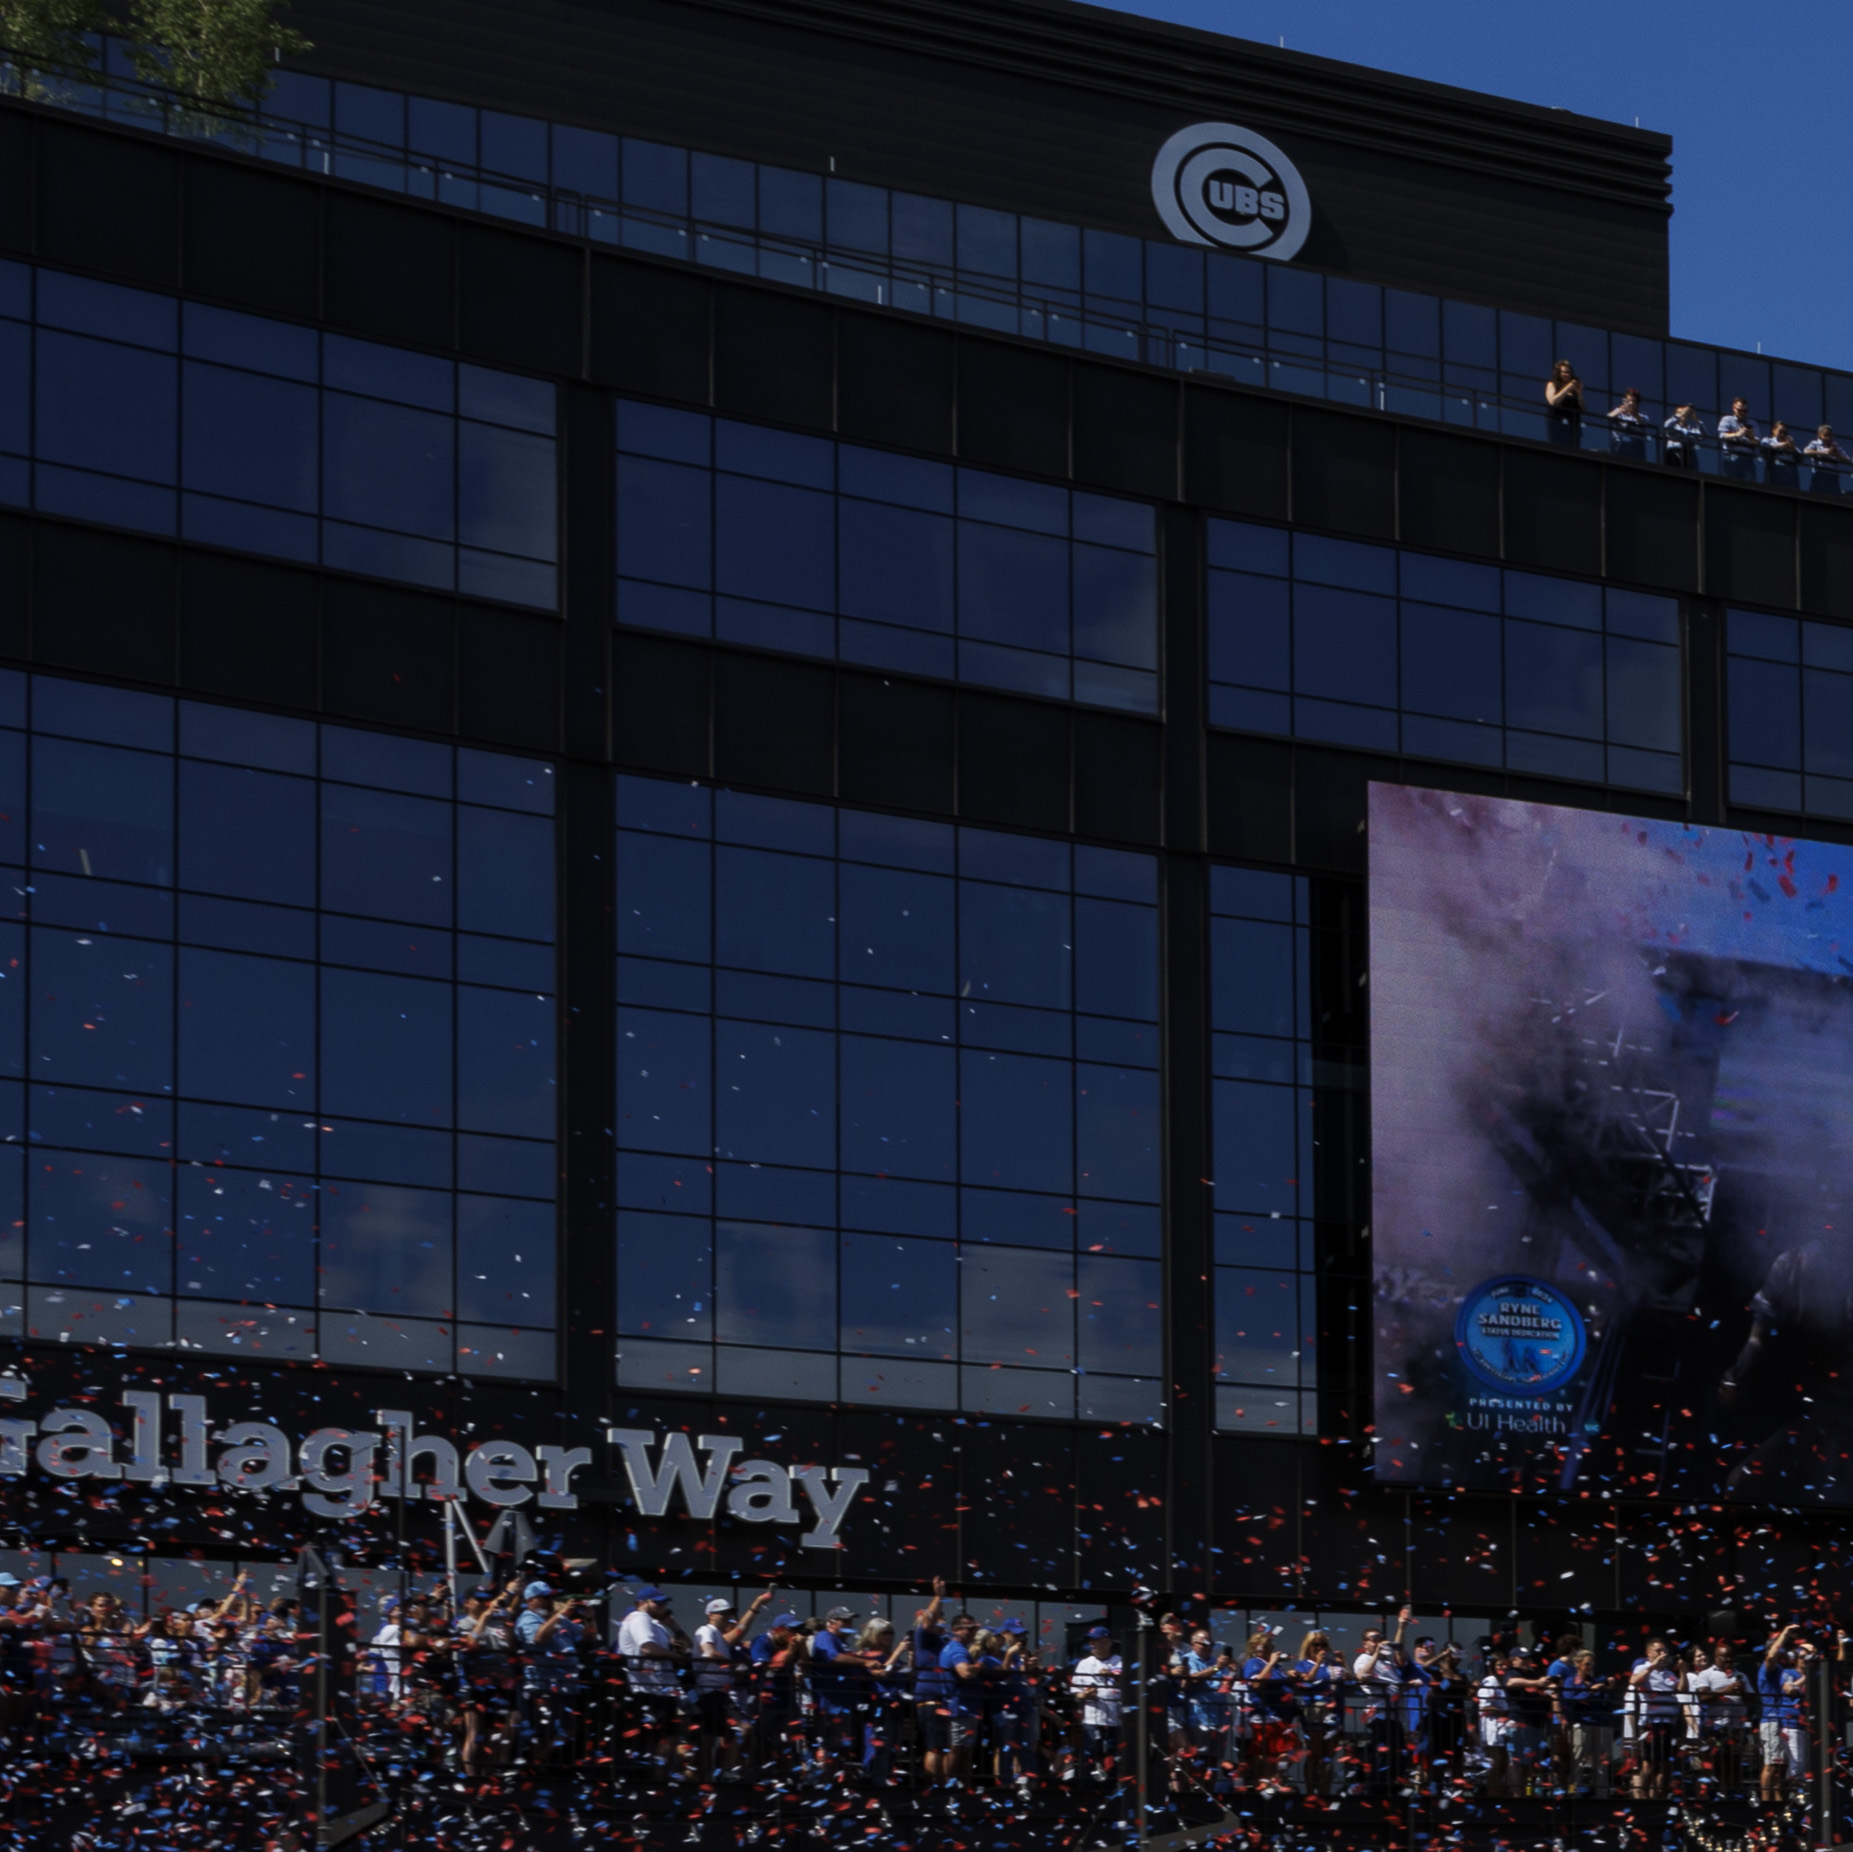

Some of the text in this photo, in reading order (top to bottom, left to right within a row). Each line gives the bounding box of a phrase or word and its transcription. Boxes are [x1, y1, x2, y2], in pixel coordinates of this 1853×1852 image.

[1500, 1302, 1541, 1315] RYNE
[1478, 1313, 1563, 1330] SANDBERG
[1469, 1397, 1574, 1412] PRESENTED BY
[1497, 1413, 1567, 1435] Health
[607, 1426, 870, 1549] Way
